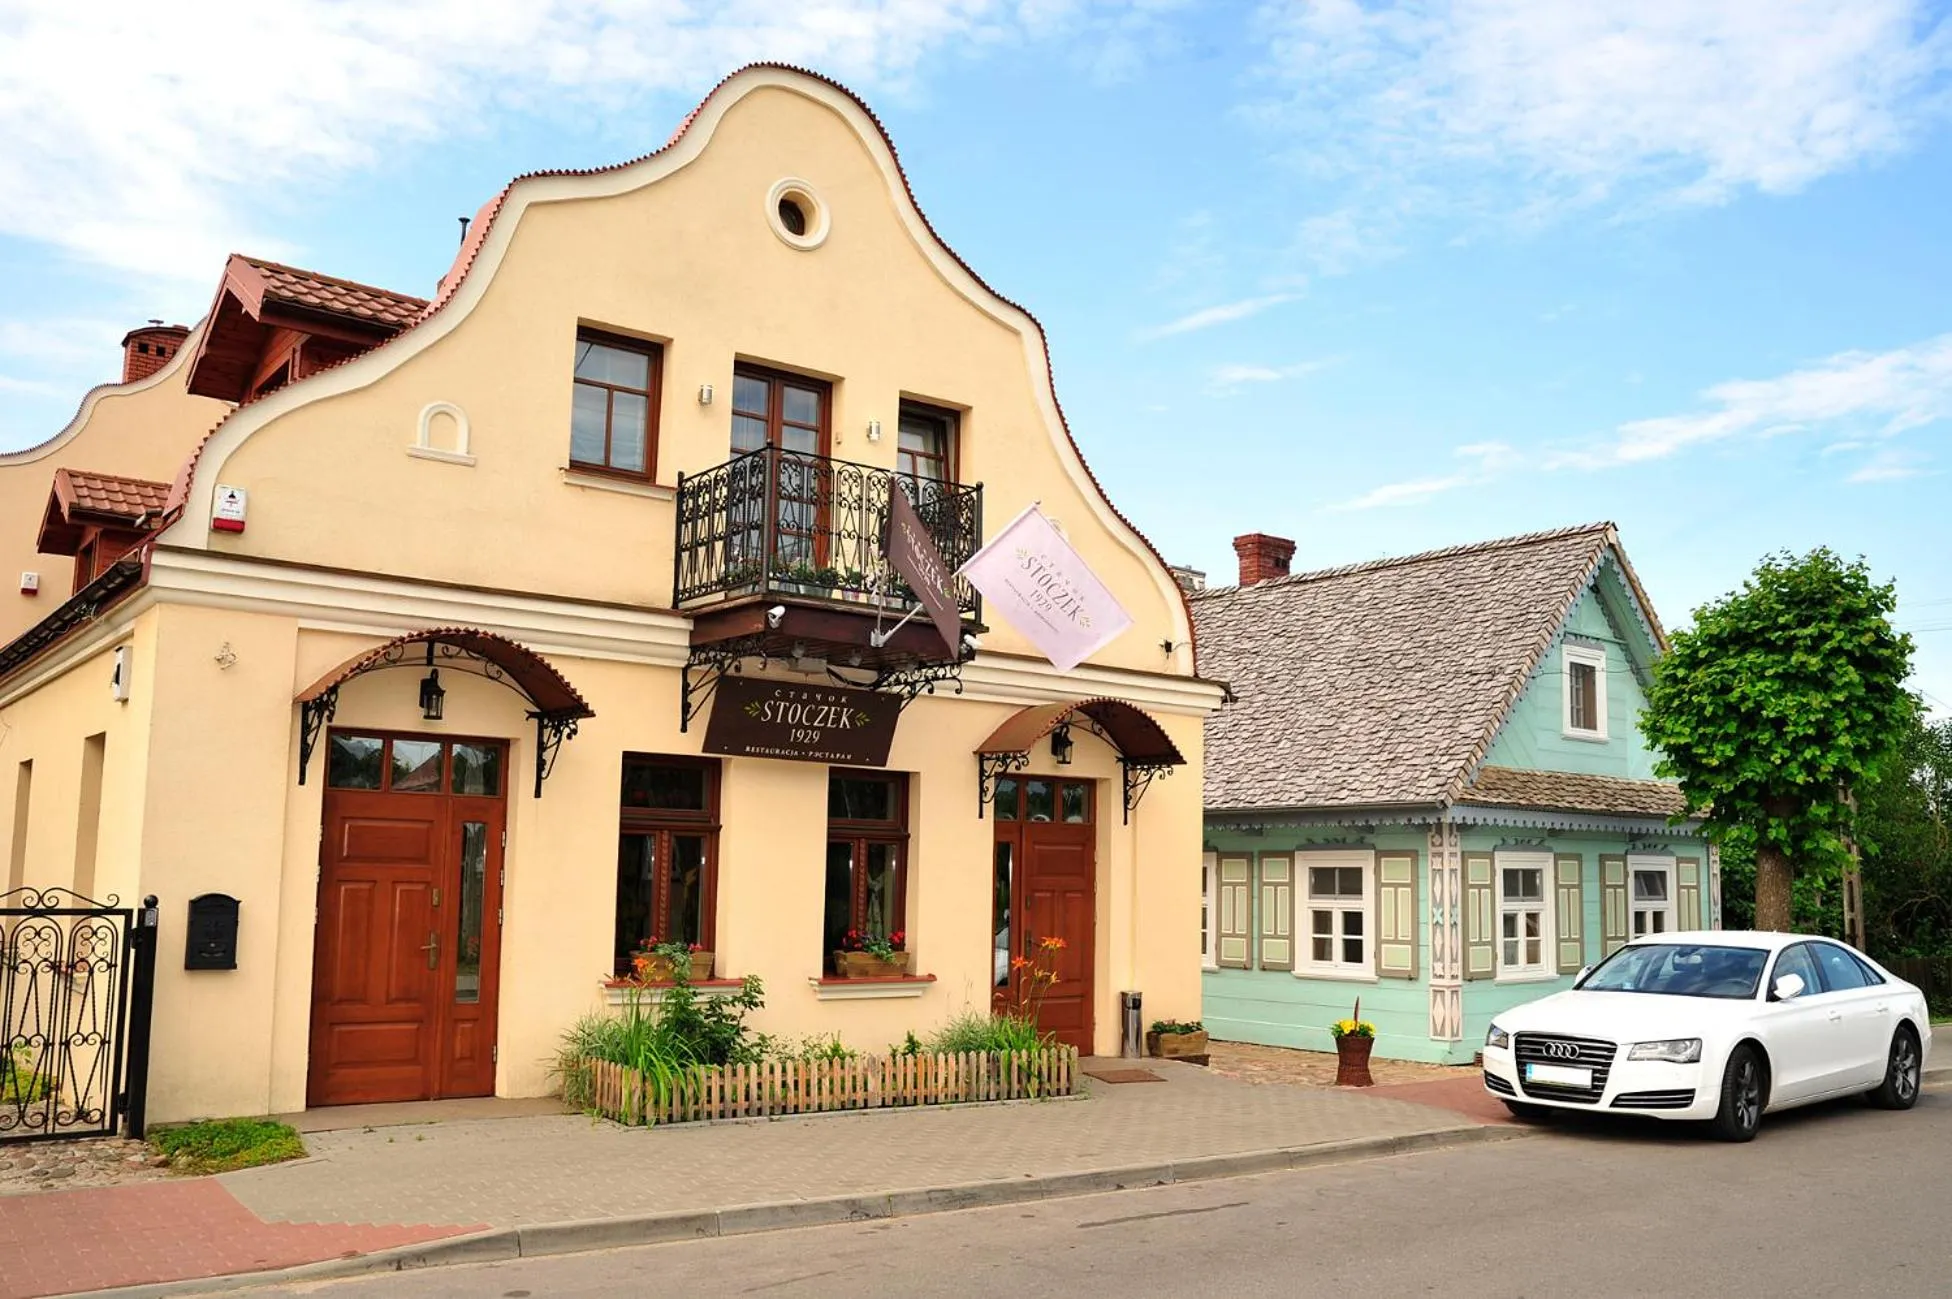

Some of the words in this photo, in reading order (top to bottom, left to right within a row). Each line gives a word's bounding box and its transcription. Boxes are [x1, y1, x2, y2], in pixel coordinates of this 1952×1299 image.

[1020, 556, 1084, 622] STOCZEK
[761, 700, 854, 729] STOCZEK
[789, 728, 821, 744] 1929
[745, 745, 799, 757] RESTAURACJA
